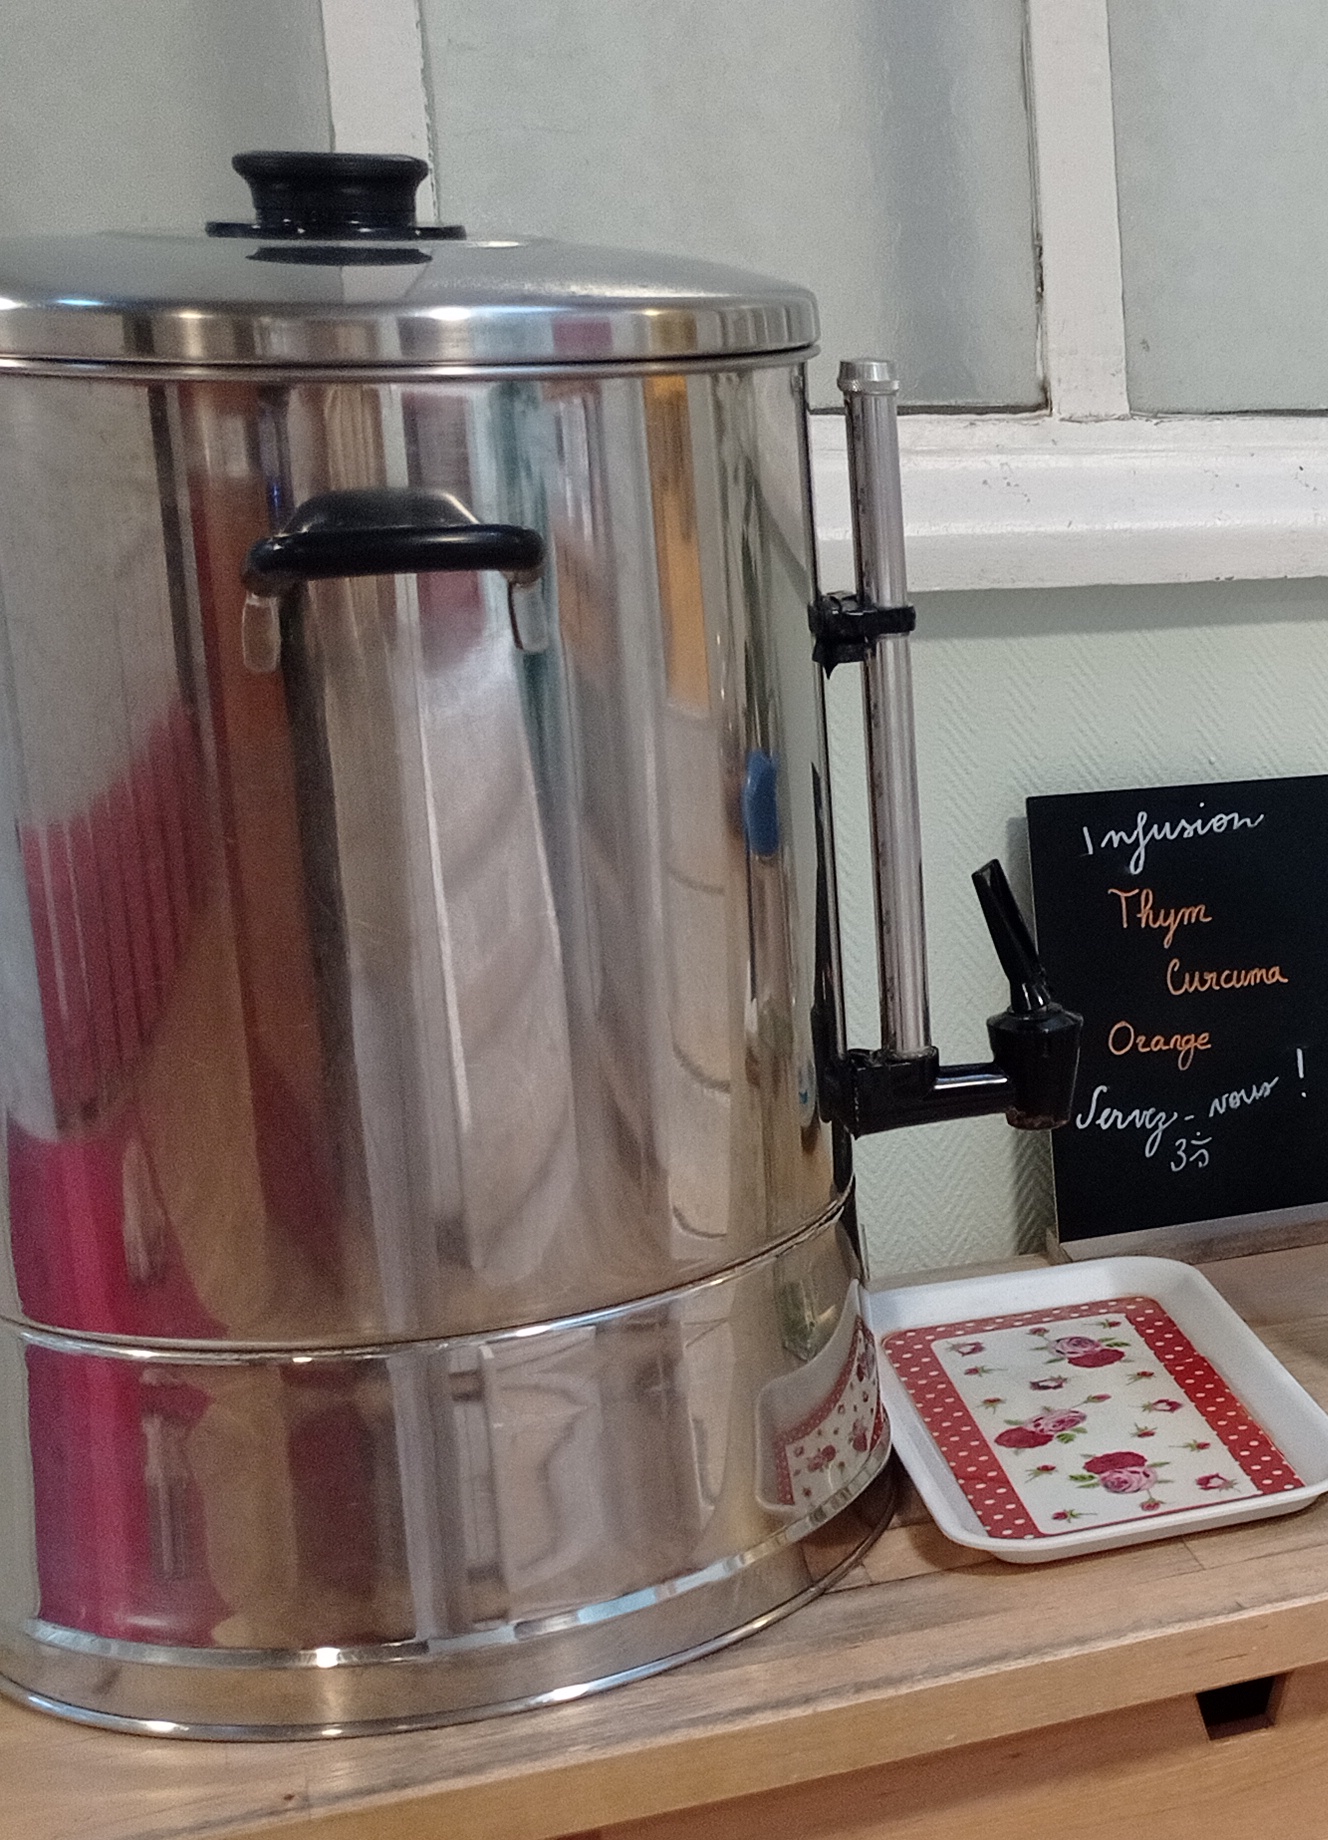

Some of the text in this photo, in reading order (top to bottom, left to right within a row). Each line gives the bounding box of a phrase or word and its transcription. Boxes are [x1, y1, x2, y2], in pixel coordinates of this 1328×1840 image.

[1083, 802, 1265, 875] Infusion
[1108, 888, 1213, 949] Thym
[1167, 958, 1289, 996] Curcuma
[1108, 1020, 1212, 1071] Orange
